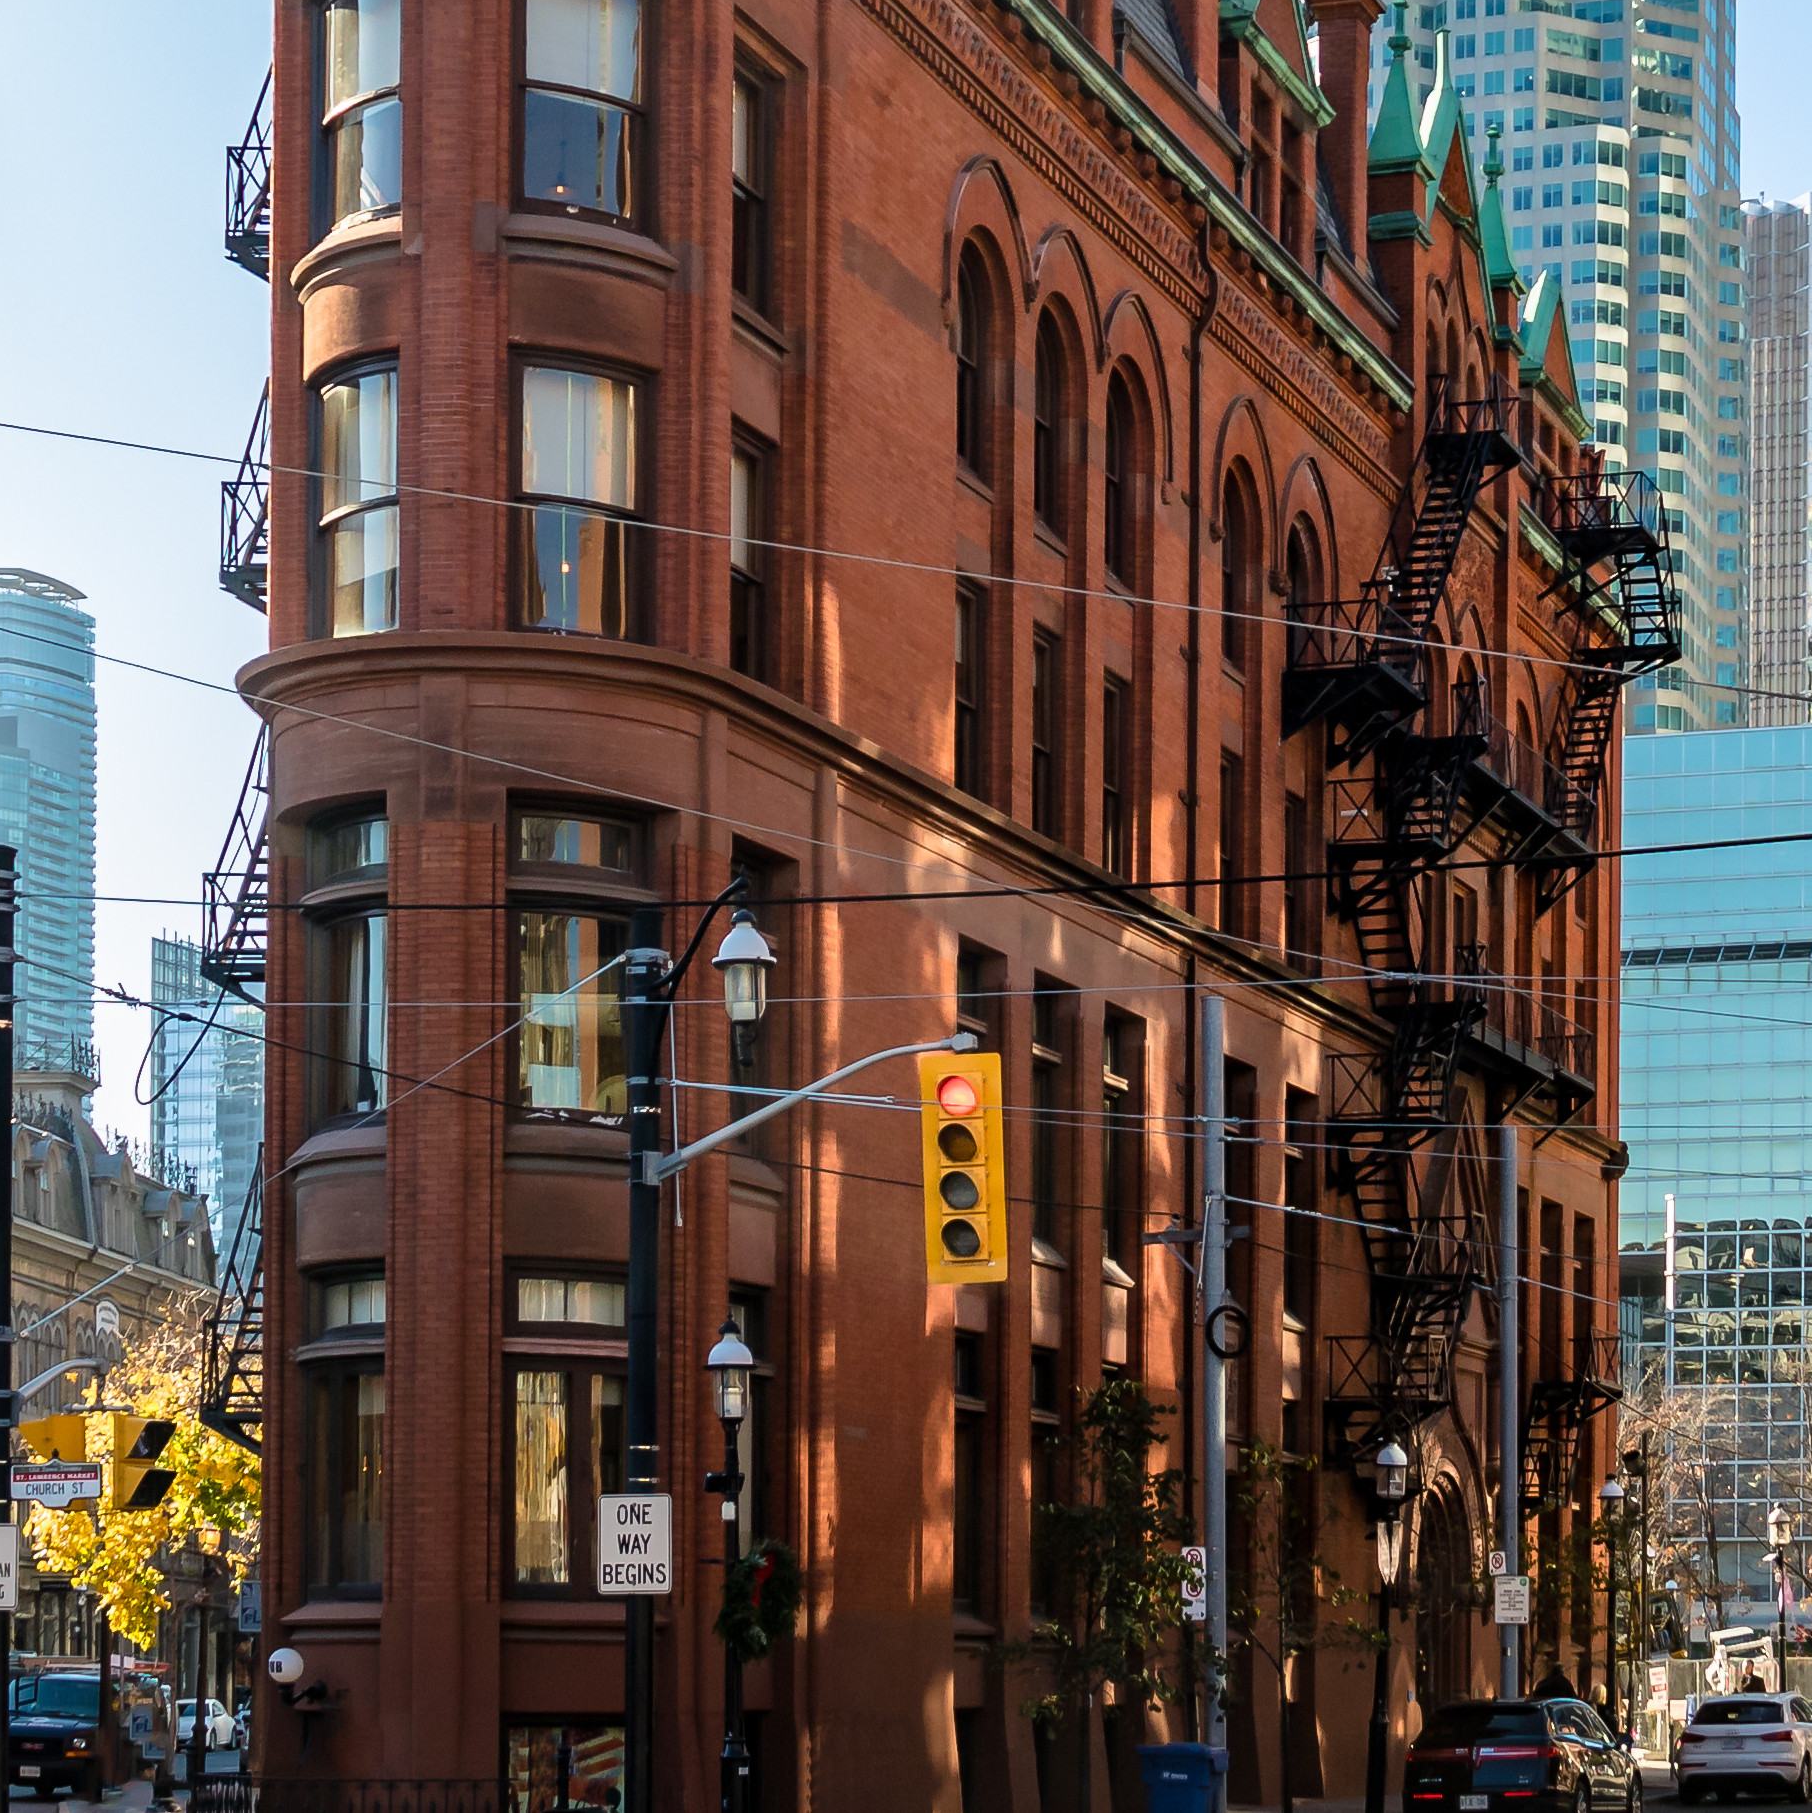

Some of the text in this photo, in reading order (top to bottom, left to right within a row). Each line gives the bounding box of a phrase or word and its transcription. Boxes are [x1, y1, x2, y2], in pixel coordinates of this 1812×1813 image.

[67, 1472, 96, 1480] MARKET
[25, 1482, 65, 1496] CHURCH
[616, 1503, 652, 1525] ONE
[617, 1533, 652, 1555] WAY
[602, 1563, 667, 1585] BEGINS
